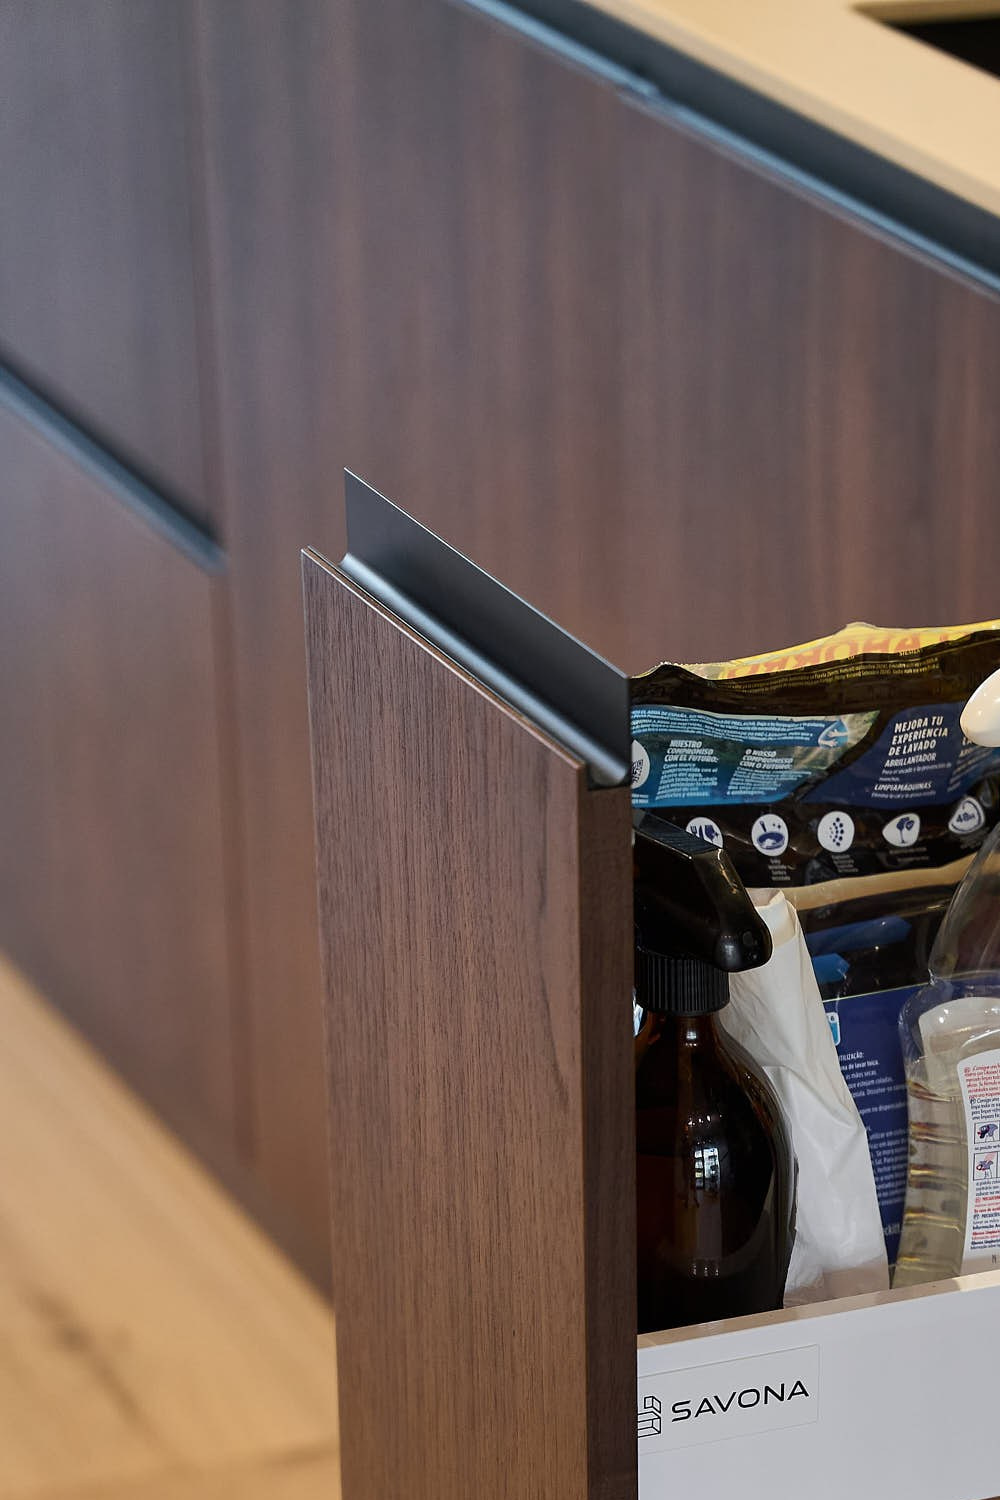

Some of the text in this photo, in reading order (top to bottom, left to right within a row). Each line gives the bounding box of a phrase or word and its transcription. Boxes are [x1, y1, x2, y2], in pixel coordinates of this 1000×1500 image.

[894, 716, 944, 734] MEJORA TU
[892, 727, 948, 746] EXPERIENCIA
[669, 739, 702, 748] NUESTRO
[888, 740, 937, 756] DE LAVADO
[667, 747, 714, 755] COMPROMISO
[752, 749, 777, 757] NOSSO
[664, 754, 679, 762] CON
[679, 754, 688, 762] EL
[743, 755, 793, 764] COMPROMISSO
[884, 753, 937, 768] ABRILLANTADOR
[672, 1380, 809, 1422] SAVONA
